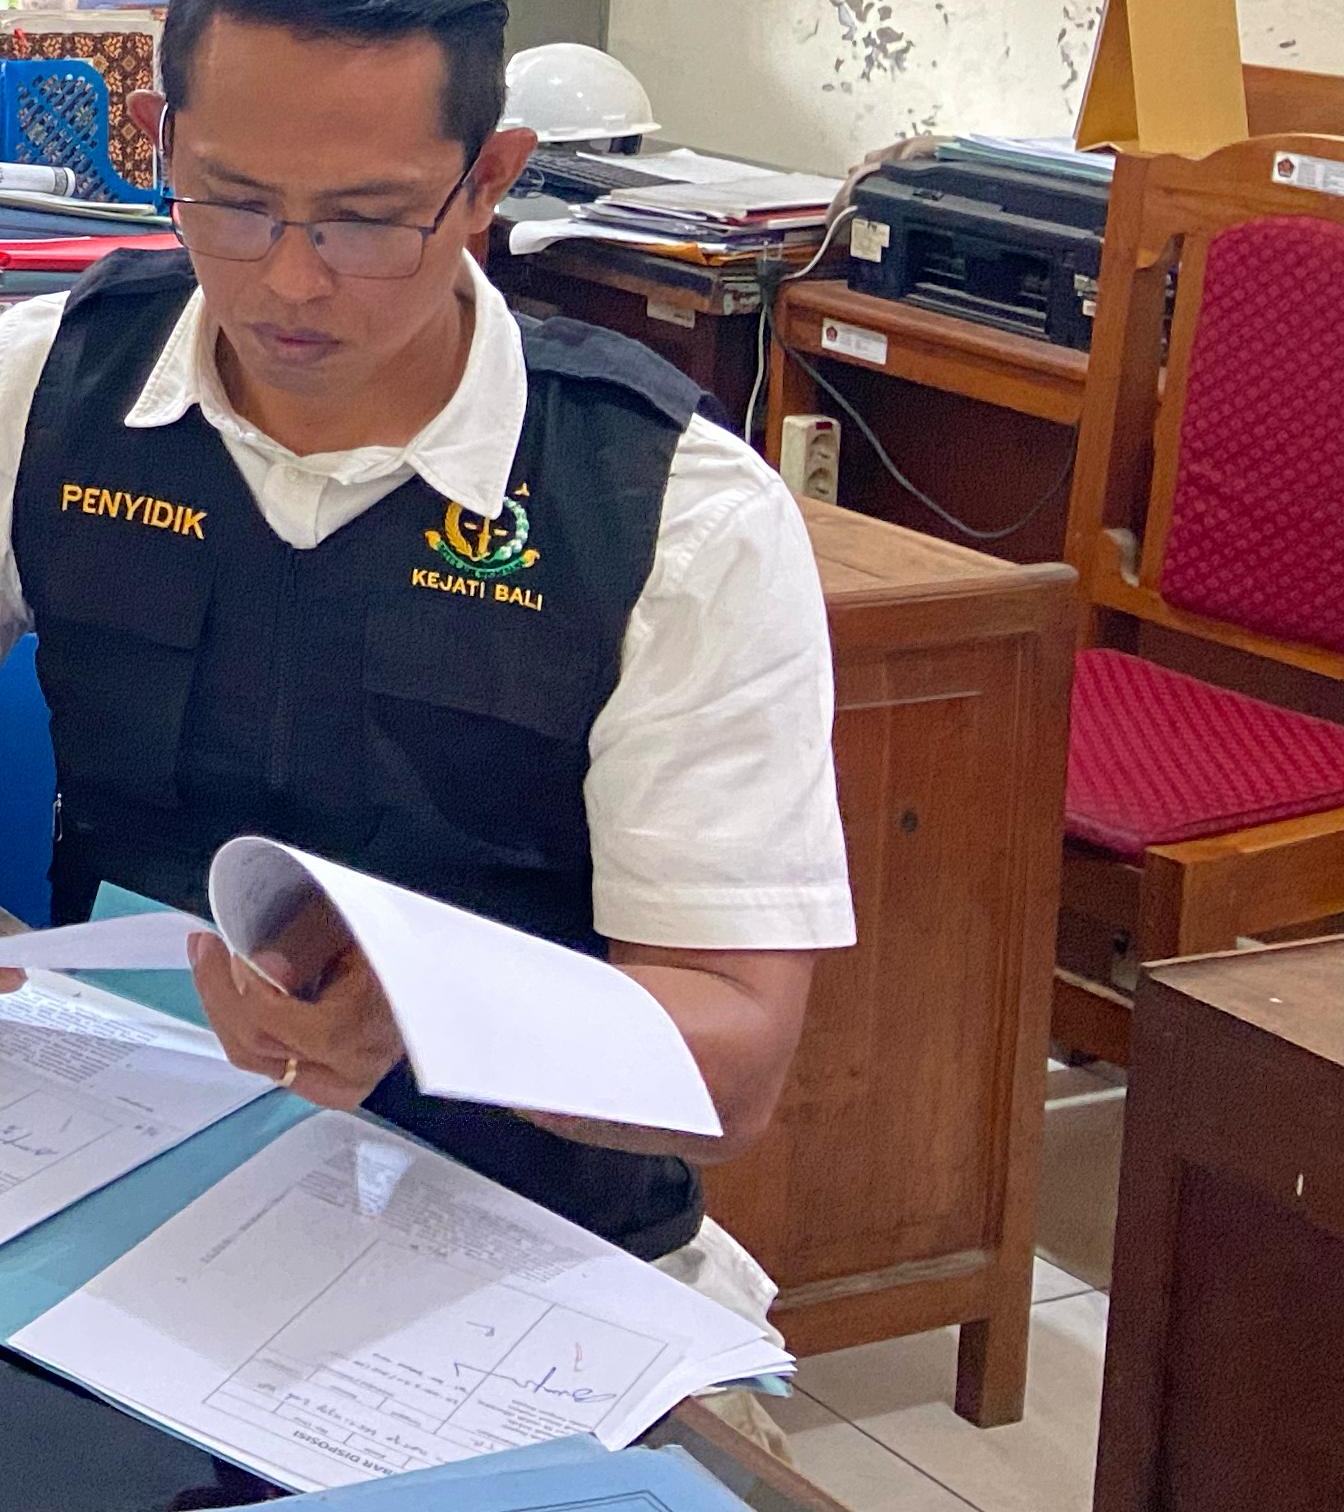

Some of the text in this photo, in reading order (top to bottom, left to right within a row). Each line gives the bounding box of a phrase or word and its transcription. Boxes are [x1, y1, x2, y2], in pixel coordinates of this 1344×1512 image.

[61, 484, 208, 540] PENYIDIK
[412, 568, 543, 611] KEJATI BALI
[292, 1430, 361, 1463] DISPOSISI
